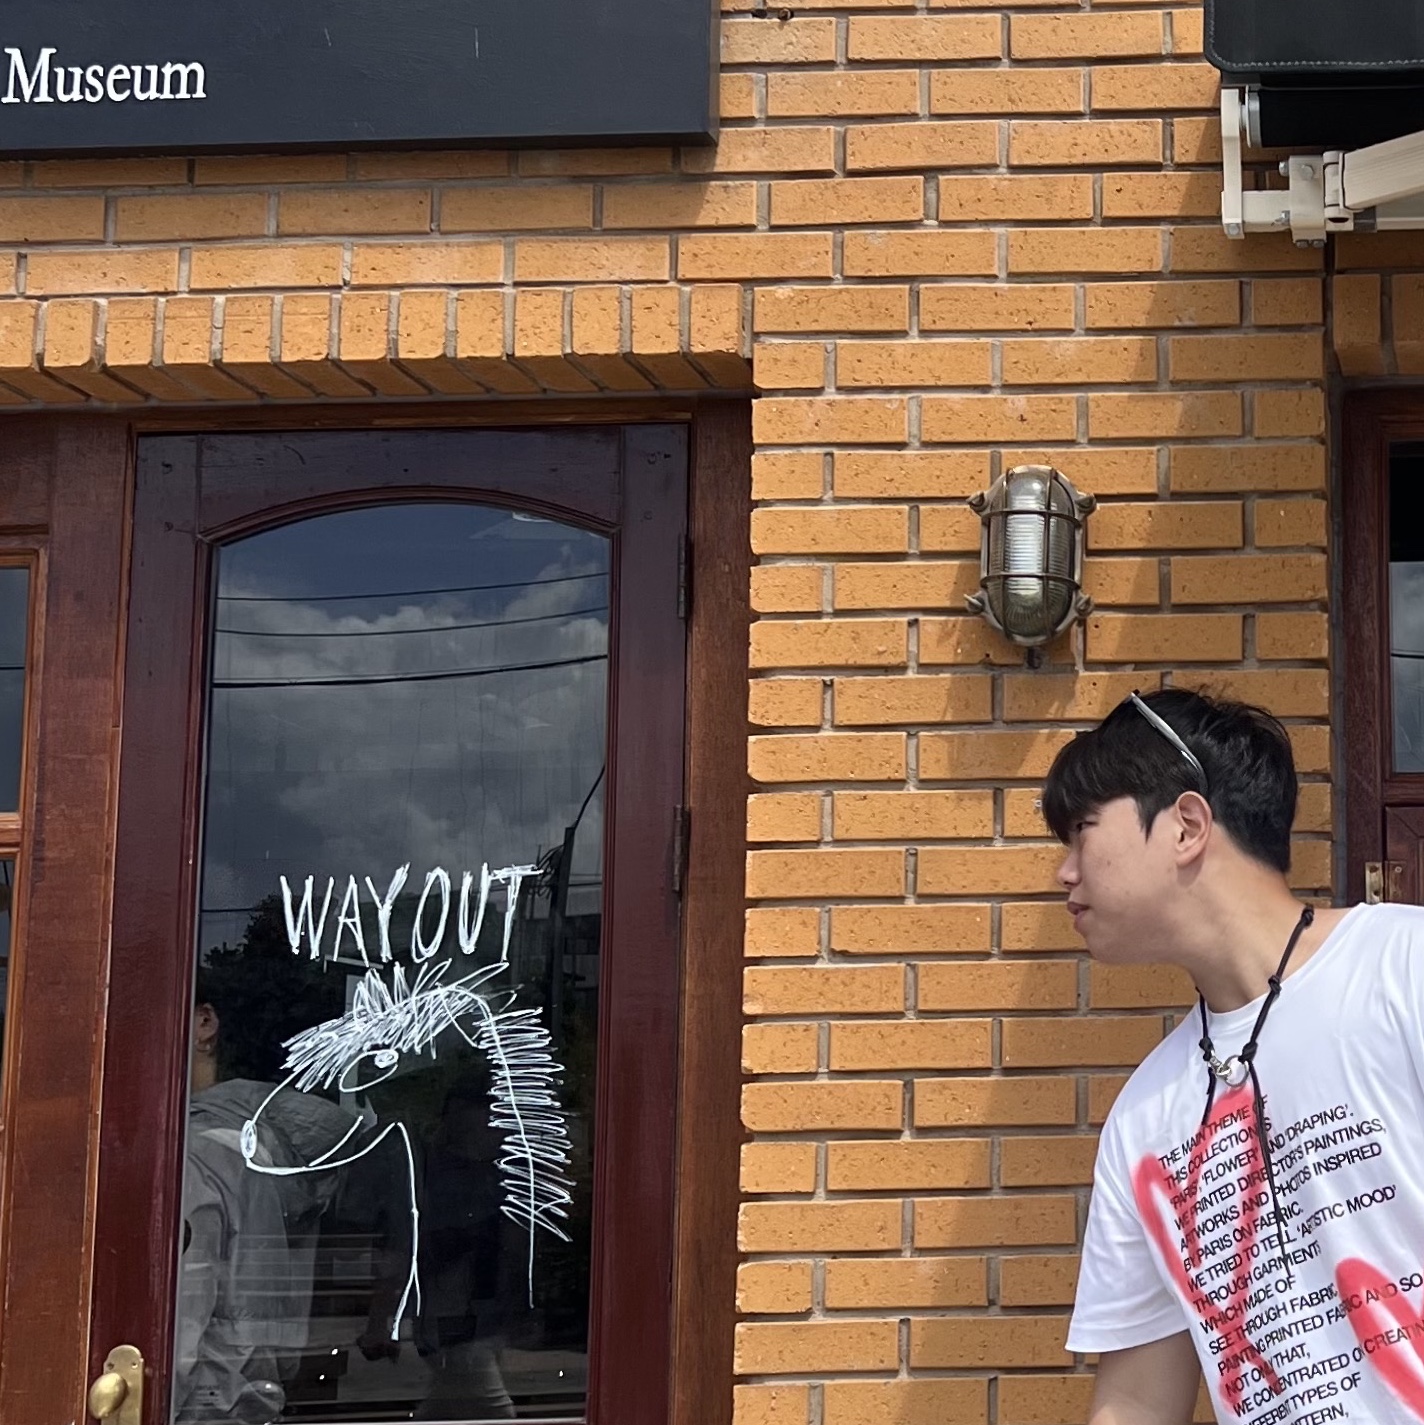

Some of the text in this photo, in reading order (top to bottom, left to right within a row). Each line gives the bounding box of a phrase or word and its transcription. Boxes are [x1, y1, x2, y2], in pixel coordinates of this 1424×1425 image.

[1, 46, 207, 103] Museum
[279, 862, 544, 968] WAY OUT
[1158, 1148, 1183, 1170] THE
[1181, 1131, 1206, 1156] MAIN
[1204, 1105, 1251, 1136] THEME
[1163, 1166, 1188, 1190] THIS
[1187, 1124, 1261, 1174] COLLECTION
[1264, 1133, 1286, 1154] ND
[1174, 1210, 1190, 1230] WE
[1190, 1182, 1236, 1217] PRINTED
[1303, 1118, 1387, 1155] PAINTINGS,
[1180, 1142, 1382, 1253] ARTWORKS AND PHOTOS INSPIRED
[1183, 1201, 1304, 1273] BY PARIS ON FABRIC.
[1188, 1272, 1208, 1293] WE
[1205, 1253, 1243, 1281] TRIED
[1242, 1243, 1260, 1262] TO
[1346, 1184, 1397, 1214] MOOD'
[1193, 1271, 1254, 1314] THROUGH
[1200, 1274, 1297, 1334] WHICH MADE OF
[1217, 1337, 1267, 1377] PAINTING
[1264, 1314, 1325, 1349] PRINTED
[1365, 1282, 1398, 1305] AND
[1399, 1272, 1424, 1293] SO
[1208, 1331, 1236, 1356] SEE
[1236, 1301, 1289, 1337] THROUGH
[1225, 1372, 1250, 1398] NOT
[1273, 1342, 1311, 1369] THAT,
[1233, 1397, 1255, 1418] WE
[1253, 1352, 1351, 1407] CONENTRATED
[1289, 1380, 1339, 1411] TYPES
[1340, 1371, 1362, 1392] OF
